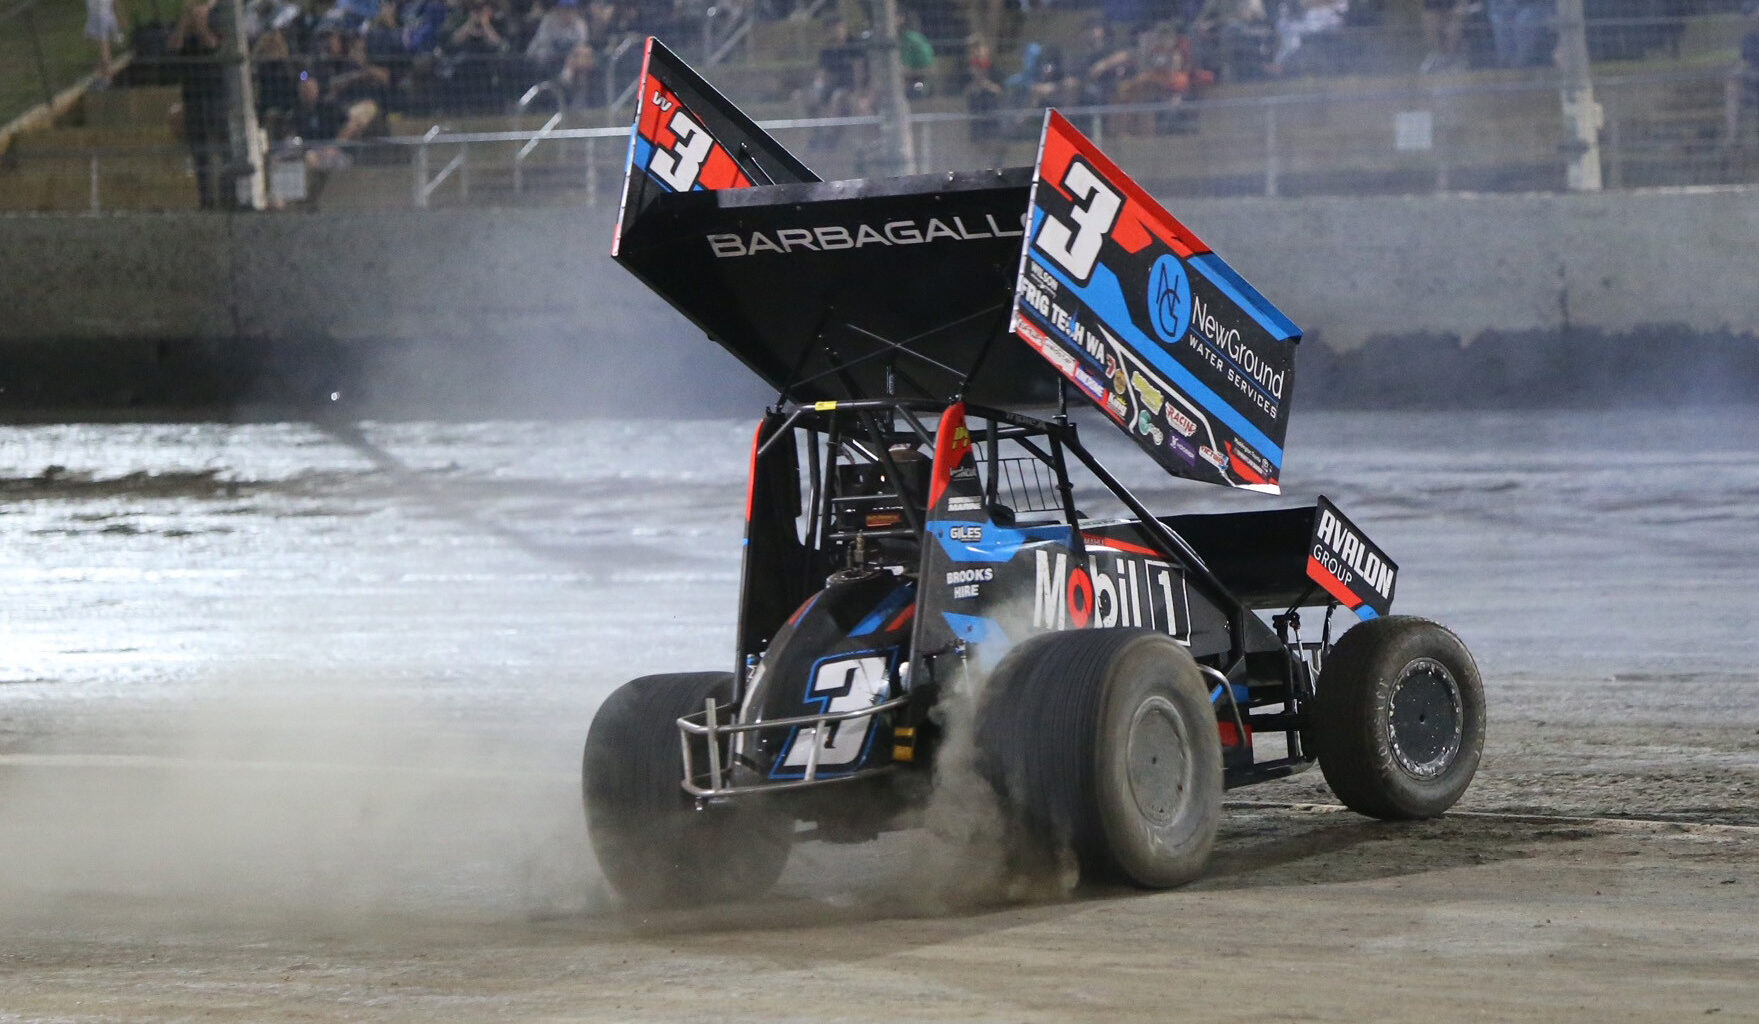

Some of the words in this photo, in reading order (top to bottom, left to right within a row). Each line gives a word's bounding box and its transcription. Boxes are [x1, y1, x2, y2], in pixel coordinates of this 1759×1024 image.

[649, 111, 713, 192] 3
[706, 213, 1028, 258] BARBAGALL
[1035, 161, 1122, 281] 3
[1019, 276, 1050, 318] FRIG
[1086, 331, 1105, 365] WA
[1191, 296, 1285, 400] NewGround
[1189, 335, 1224, 373] WATER
[1227, 369, 1278, 419] SERVICES
[946, 567, 994, 584] BROOKS
[1033, 549, 1142, 631] Mobil
[1157, 569, 1177, 636] 1
[1313, 544, 1352, 586] GROUP
[1317, 509, 1394, 600] AVALON
[784, 656, 888, 767] 3
